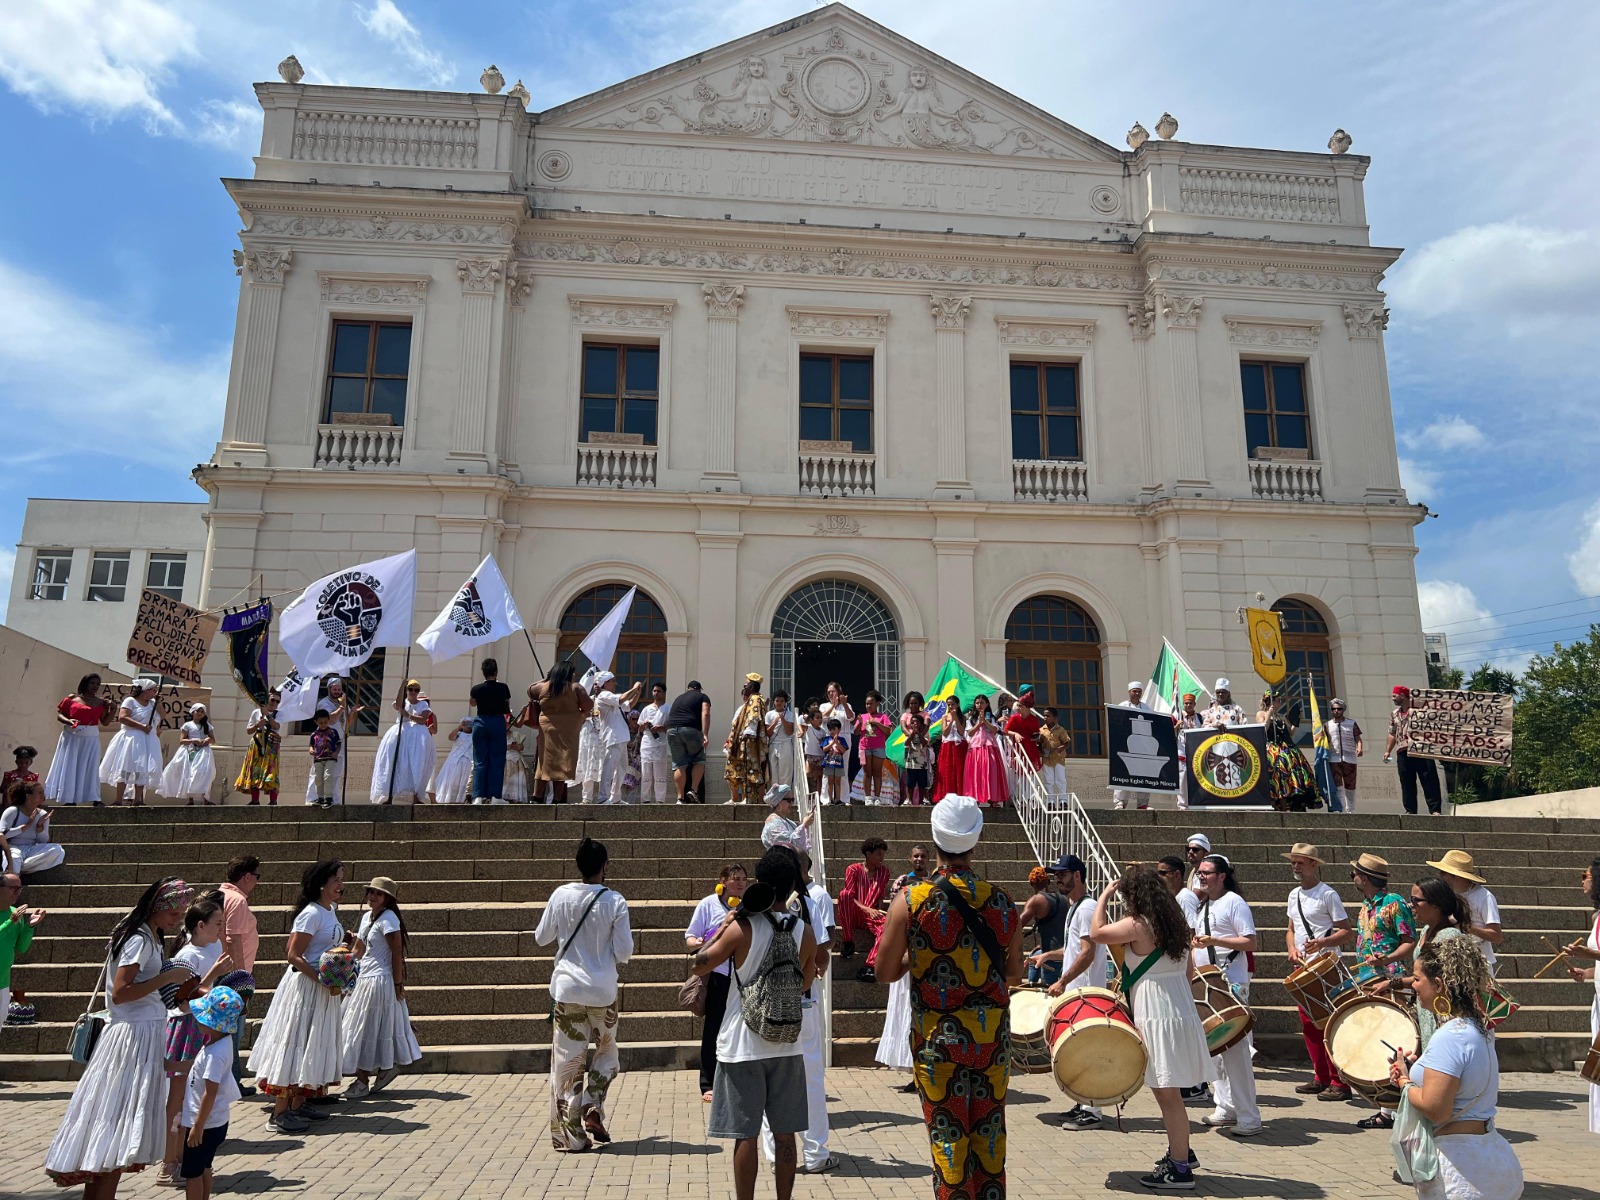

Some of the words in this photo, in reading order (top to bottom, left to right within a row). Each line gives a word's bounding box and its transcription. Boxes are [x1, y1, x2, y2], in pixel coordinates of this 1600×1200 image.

[902, 186, 938, 208] EM
[316, 572, 361, 610] COLETIVO
[365, 575, 381, 591] DE
[139, 603, 186, 630] CÂMARA
[142, 591, 177, 613] ORAR
[183, 607, 199, 623] NA
[144, 631, 205, 663] GOVERNAR
[156, 648, 180, 664] SEM
[128, 647, 201, 684] PRECONCEITO
[1411, 688, 1420, 698] O
[1425, 689, 1486, 702] ESTADO
[1472, 703, 1503, 714] MAS
[1410, 720, 1462, 733] DIANTE
[1474, 726, 1495, 737] DE
[1410, 741, 1437, 754] ATÉ
[1440, 745, 1511, 764] QUANDO?
